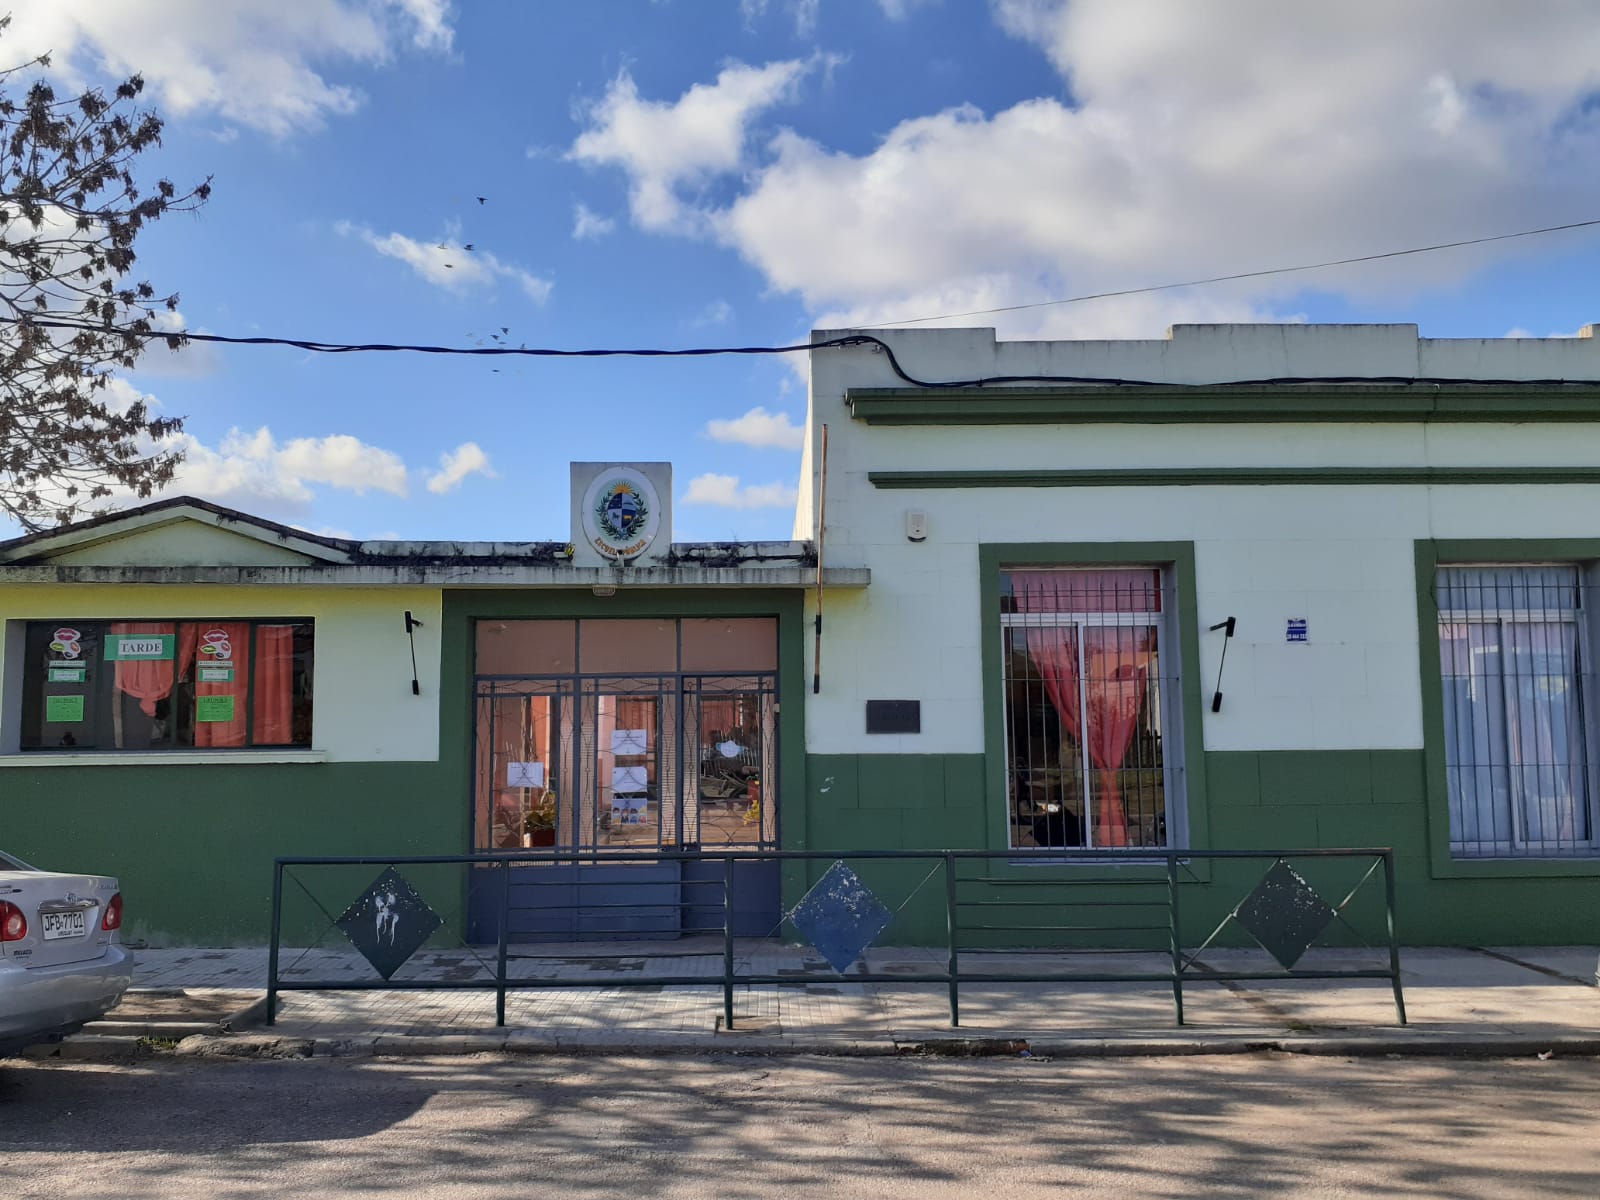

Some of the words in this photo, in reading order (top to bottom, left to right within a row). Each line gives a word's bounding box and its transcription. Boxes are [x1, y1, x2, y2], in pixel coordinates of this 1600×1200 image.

[594, 537, 619, 556] ESCUEL
[120, 643, 162, 653] TARDE
[45, 914, 60, 931] JFB
